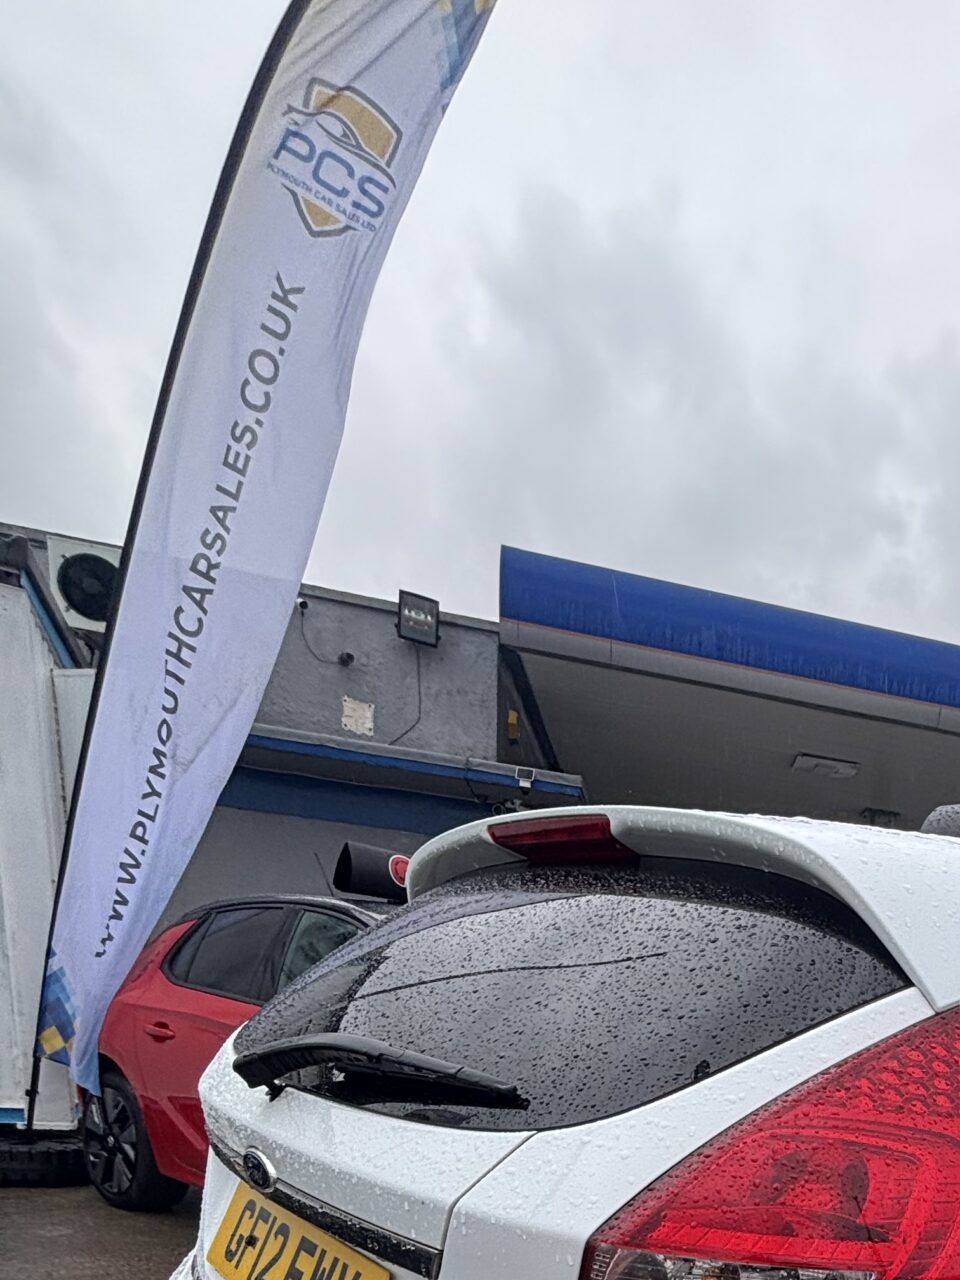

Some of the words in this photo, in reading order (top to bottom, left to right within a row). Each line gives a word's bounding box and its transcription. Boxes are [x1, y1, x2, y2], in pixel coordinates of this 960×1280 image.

[267, 161, 312, 194] PLYMOUTH
[314, 190, 334, 208] CAR
[335, 203, 361, 225] SALES
[361, 218, 377, 233] LTD
[273, 127, 389, 218] PCS
[95, 271, 306, 958] WWW.PLYMOUTHCARSALES.CO.UK
